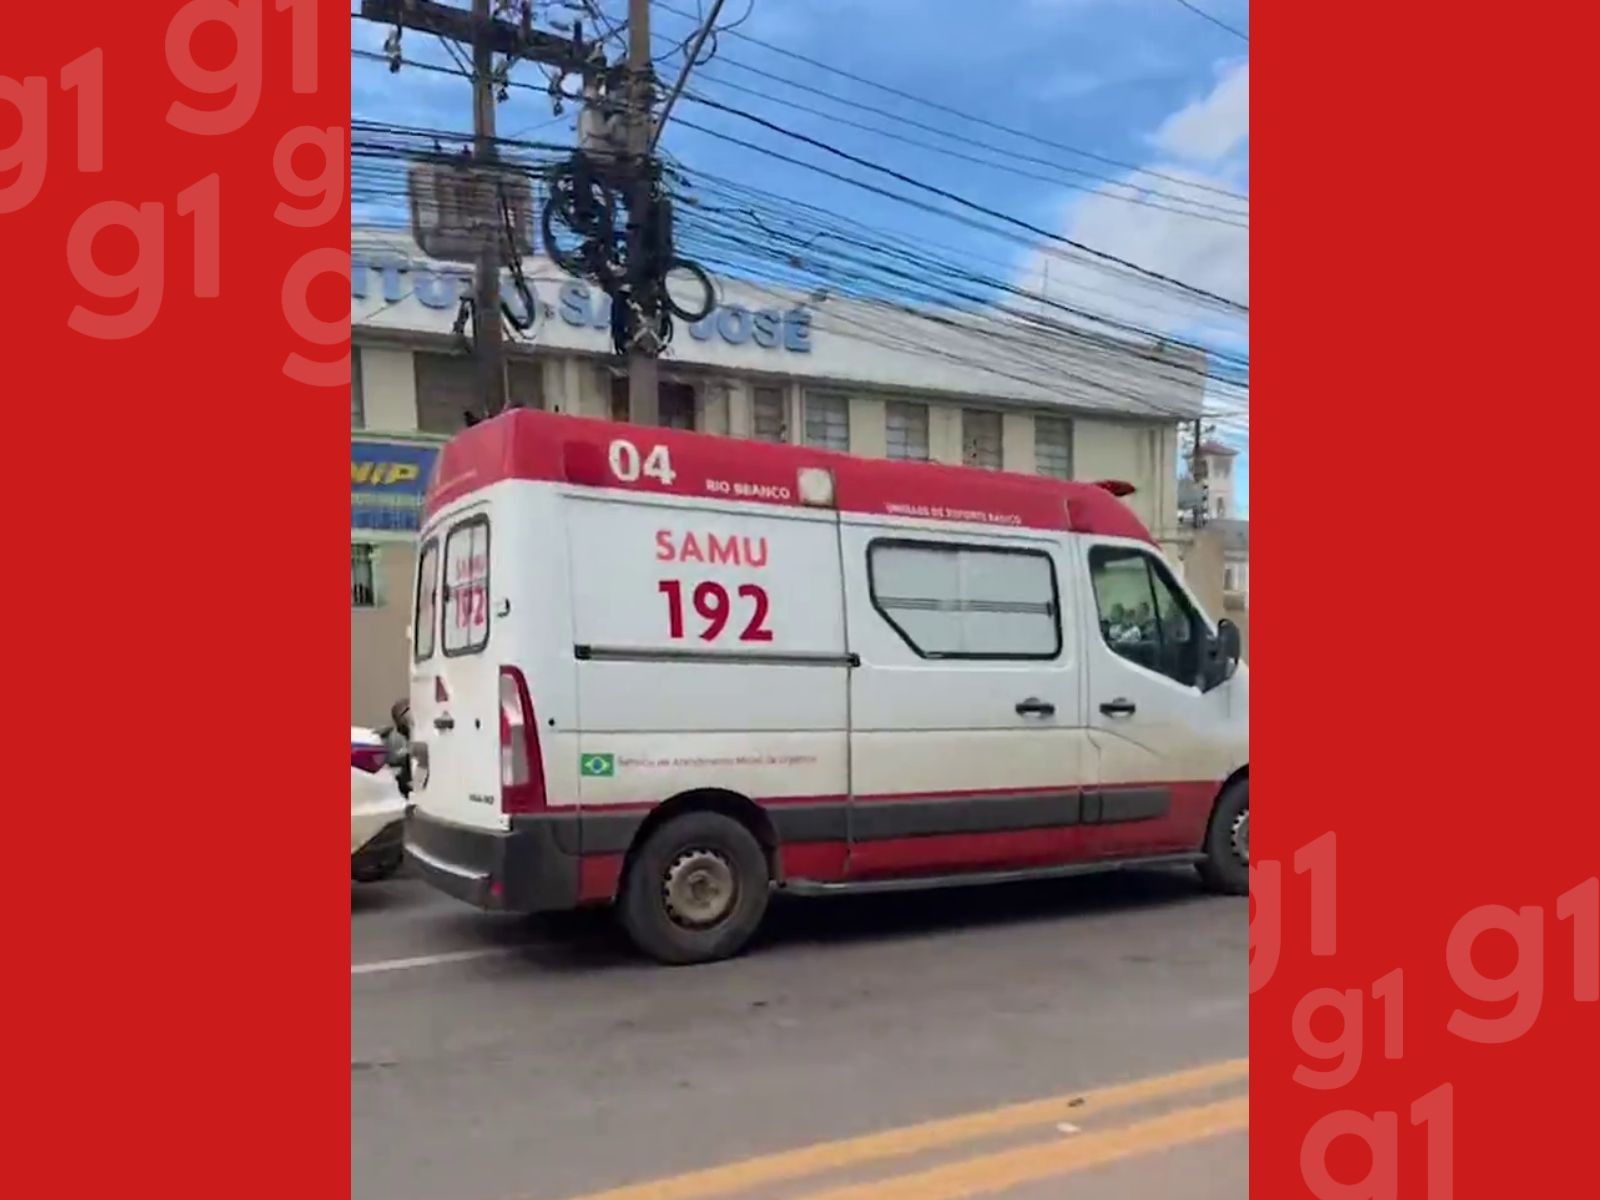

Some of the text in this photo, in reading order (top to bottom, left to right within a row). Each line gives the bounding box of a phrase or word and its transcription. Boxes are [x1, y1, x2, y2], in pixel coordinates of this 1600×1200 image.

[688, 303, 812, 353] JOSÉ
[608, 439, 677, 486] 04
[705, 479, 730, 494] RIO
[656, 530, 768, 568] SAMU
[658, 579, 774, 642] 192
